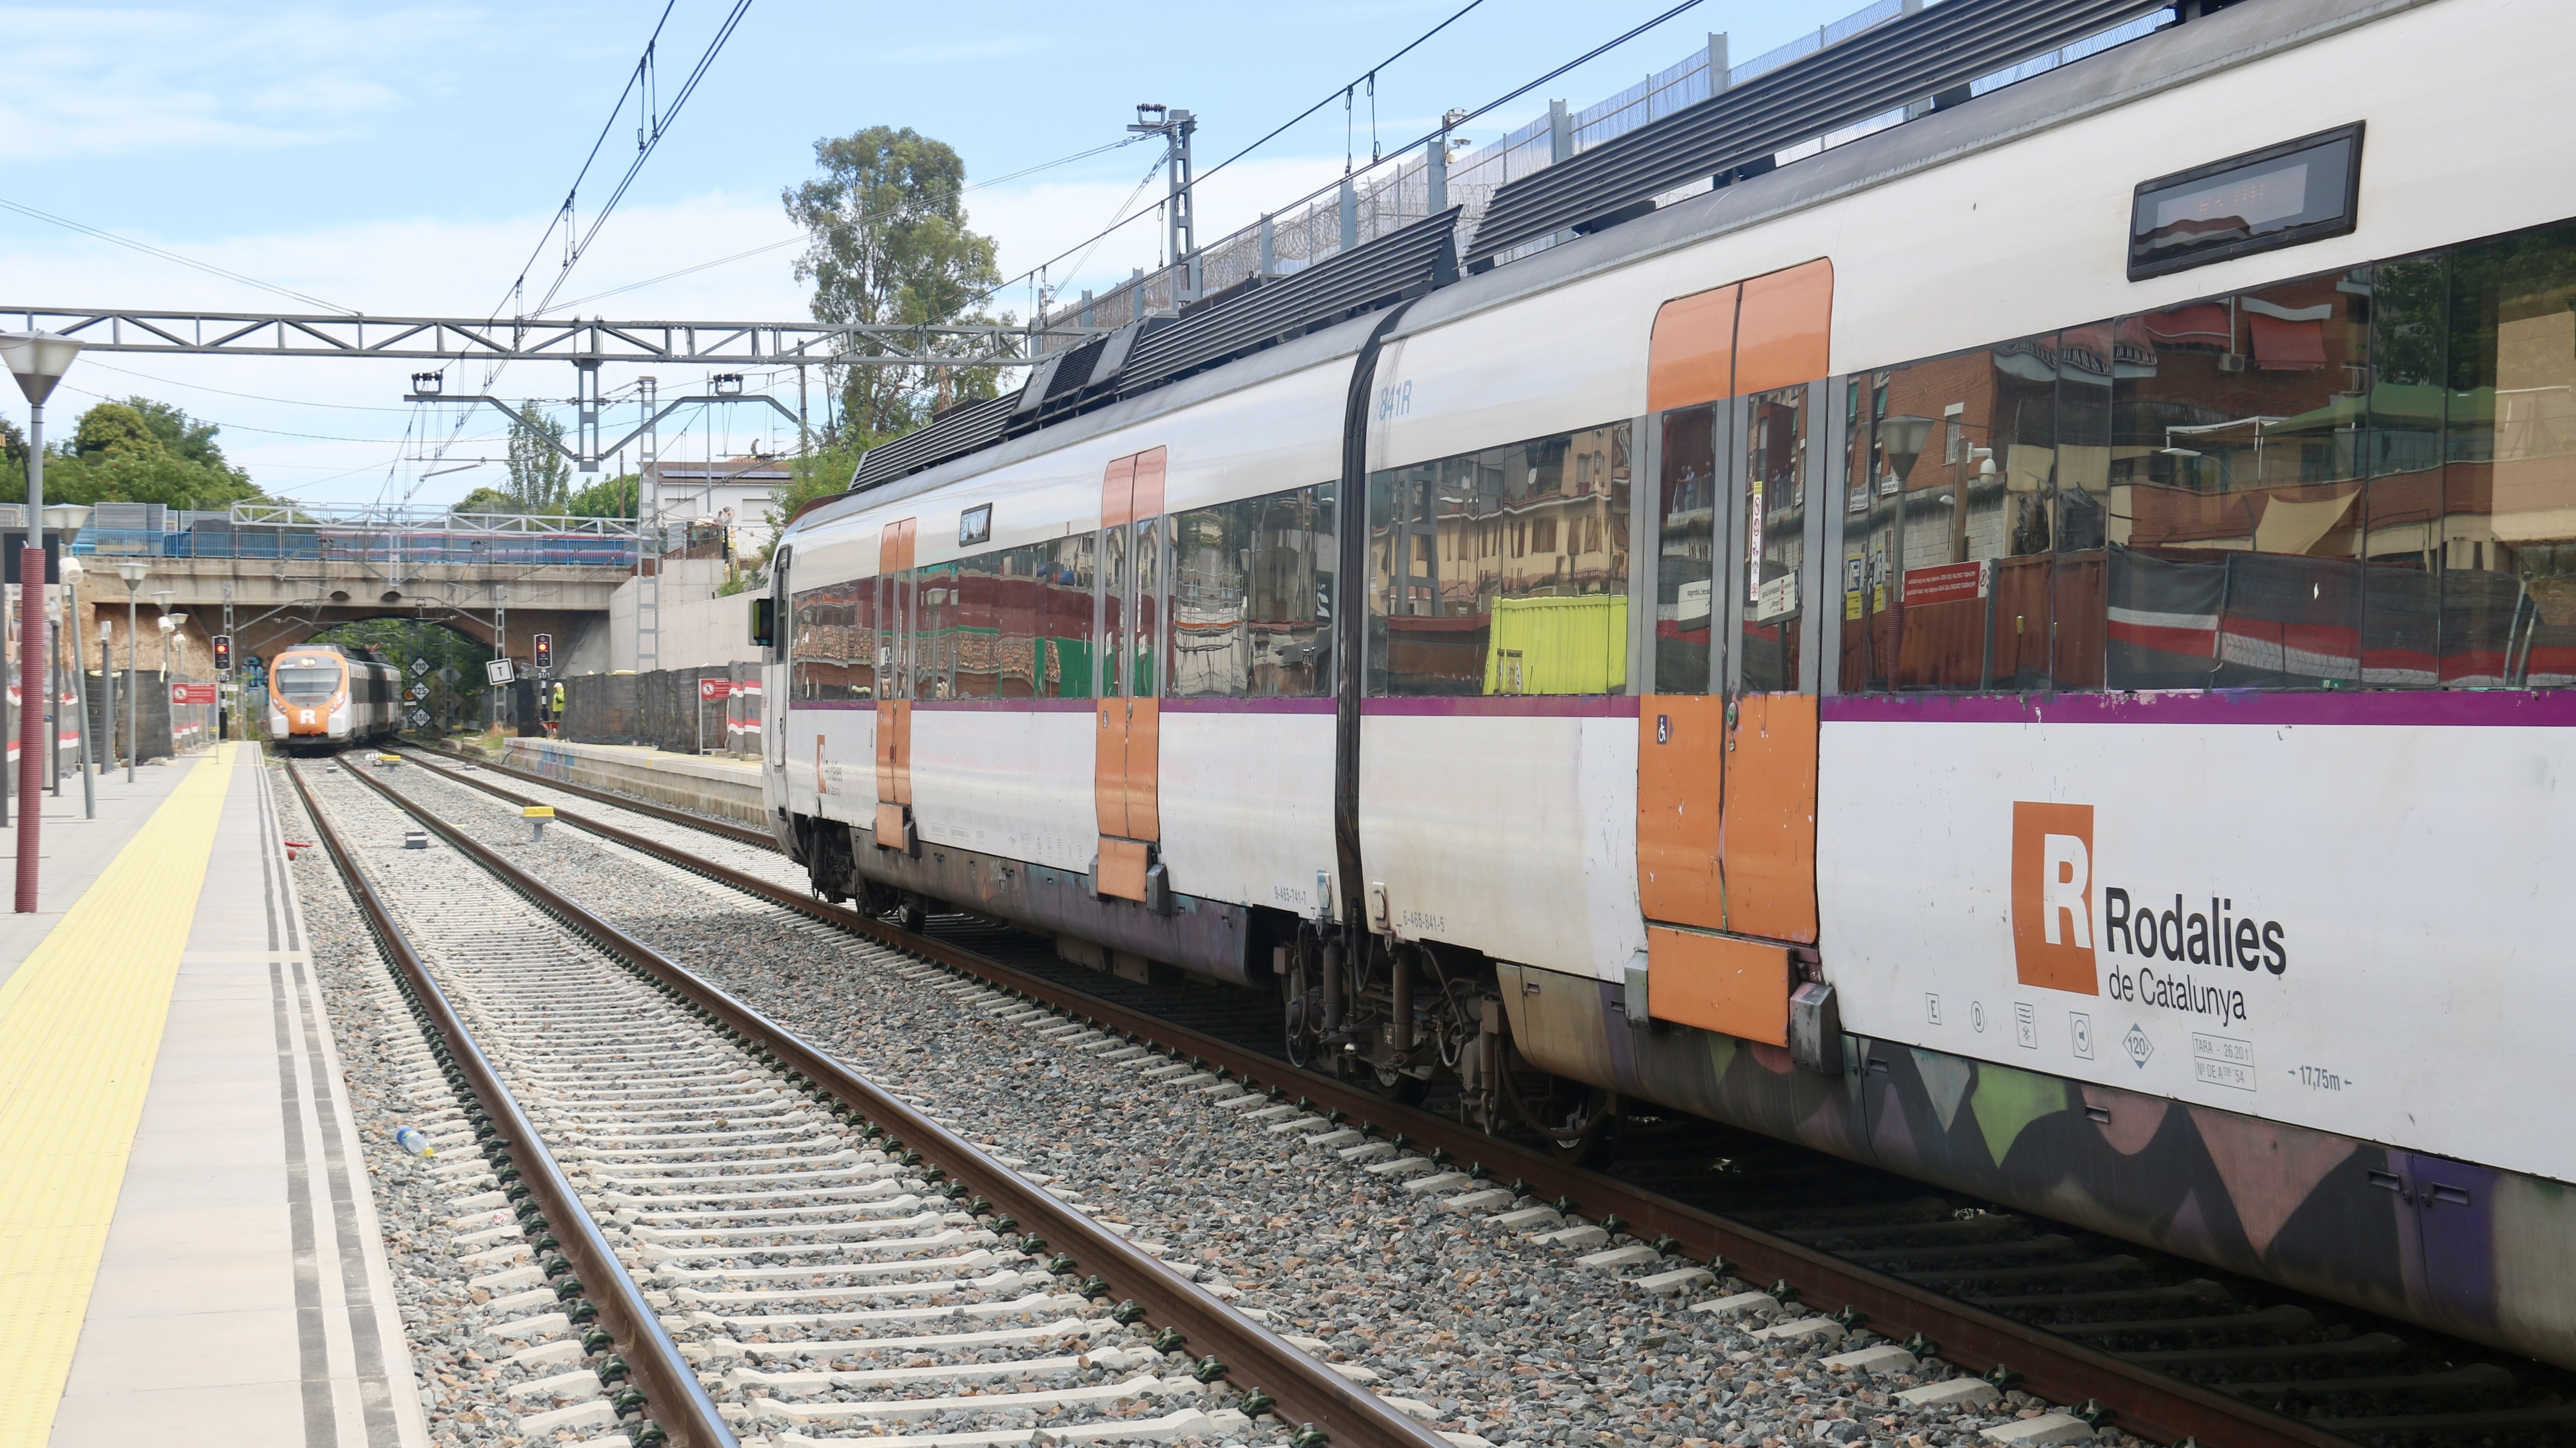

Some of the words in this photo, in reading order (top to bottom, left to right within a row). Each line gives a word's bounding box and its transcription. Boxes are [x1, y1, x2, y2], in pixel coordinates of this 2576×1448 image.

[1379, 379, 1412, 420] 841R
[497, 667, 503, 676] T
[300, 710, 315, 724] R
[1274, 886, 1307, 905] 9-465-741-7
[2044, 833, 2092, 949] R
[1403, 910, 1445, 933] 6-465-841-5
[2106, 887, 2286, 975] Rodalies
[2109, 965, 2133, 1001] de
[2139, 968, 2246, 1027] Catalunya
[1931, 999, 1937, 1018] E
[1975, 1007, 1981, 1026] D
[2194, 1039, 2213, 1054] TARA
[2224, 1044, 2243, 1060] 26.20
[2245, 1048, 2249, 1060] t
[2207, 1064, 2216, 1078] DE
[2299, 1065, 2340, 1091] 17,75m
